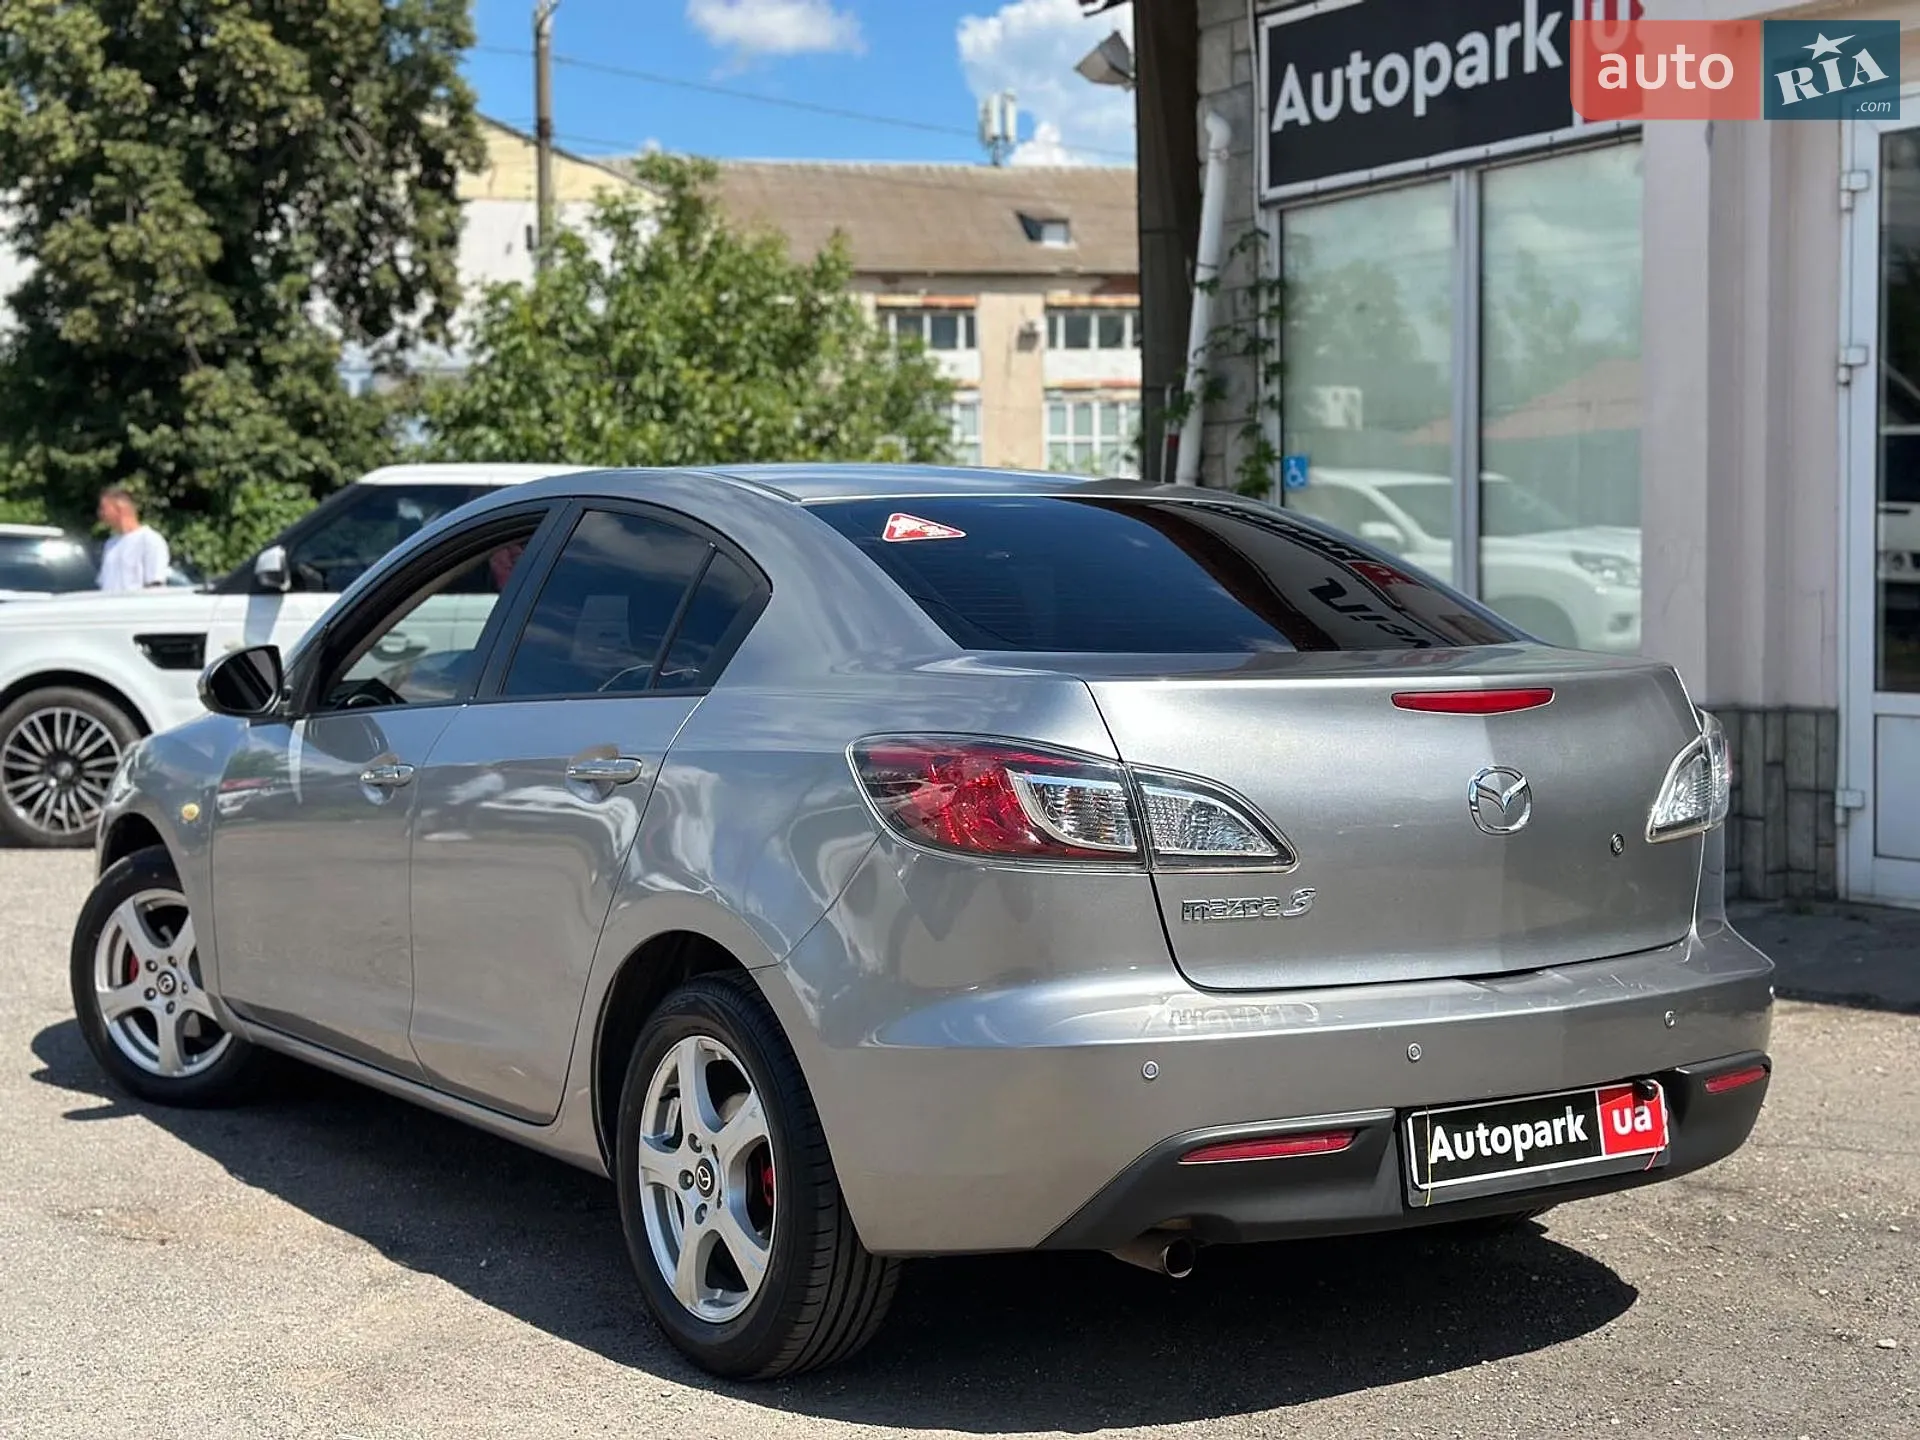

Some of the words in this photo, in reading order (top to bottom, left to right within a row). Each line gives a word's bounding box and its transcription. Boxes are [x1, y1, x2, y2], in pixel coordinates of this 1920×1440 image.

[1271, 0, 1563, 132] Autopark
[1430, 1106, 1588, 1163] Autopark
[1612, 1105, 1652, 1135] ua
